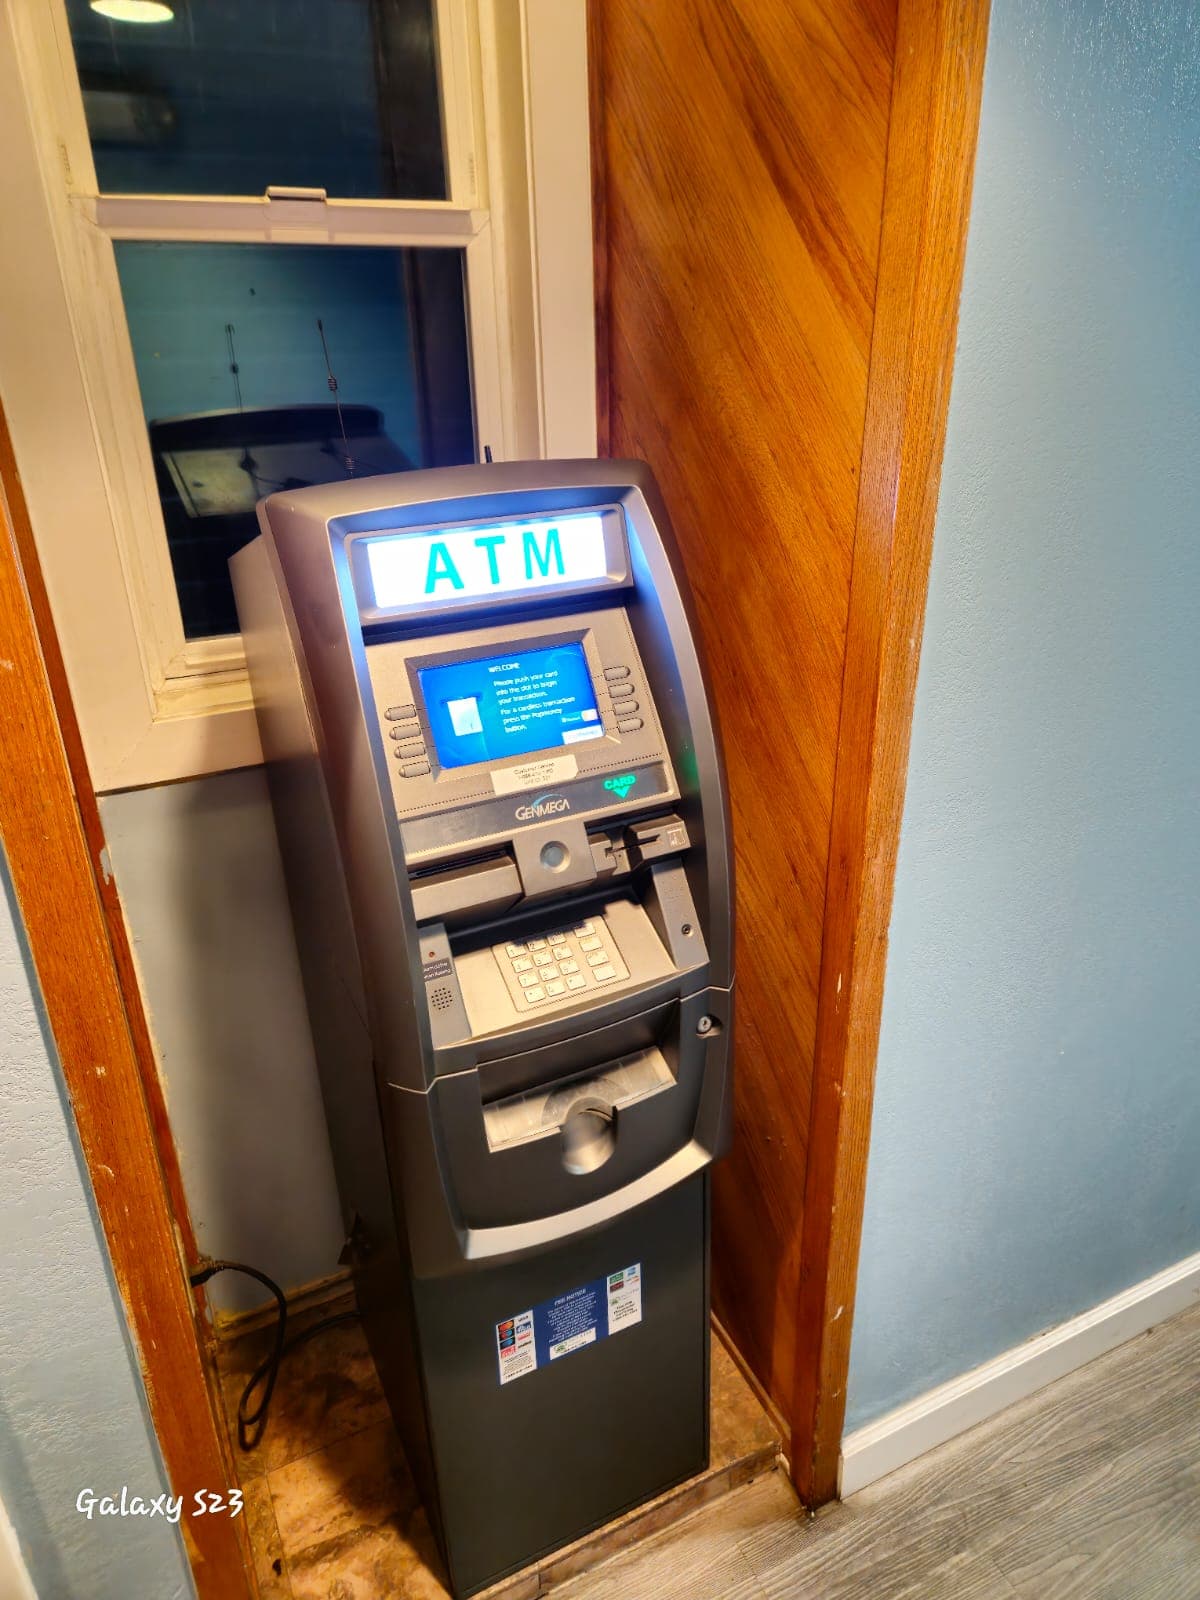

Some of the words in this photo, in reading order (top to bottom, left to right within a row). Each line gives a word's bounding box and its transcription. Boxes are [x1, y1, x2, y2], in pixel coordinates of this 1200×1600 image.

[424, 528, 565, 594] ATM
[488, 662, 520, 673] WELCOME
[493, 679, 514, 687] Please
[514, 675, 530, 684] push
[530, 673, 543, 681] your
[544, 670, 559, 678] card
[540, 680, 558, 688] begin
[518, 703, 542, 712] cardless
[542, 696, 576, 707] transaction
[502, 717, 520, 725] press
[603, 774, 636, 790] CARD
[515, 799, 570, 820] GENMEGA
